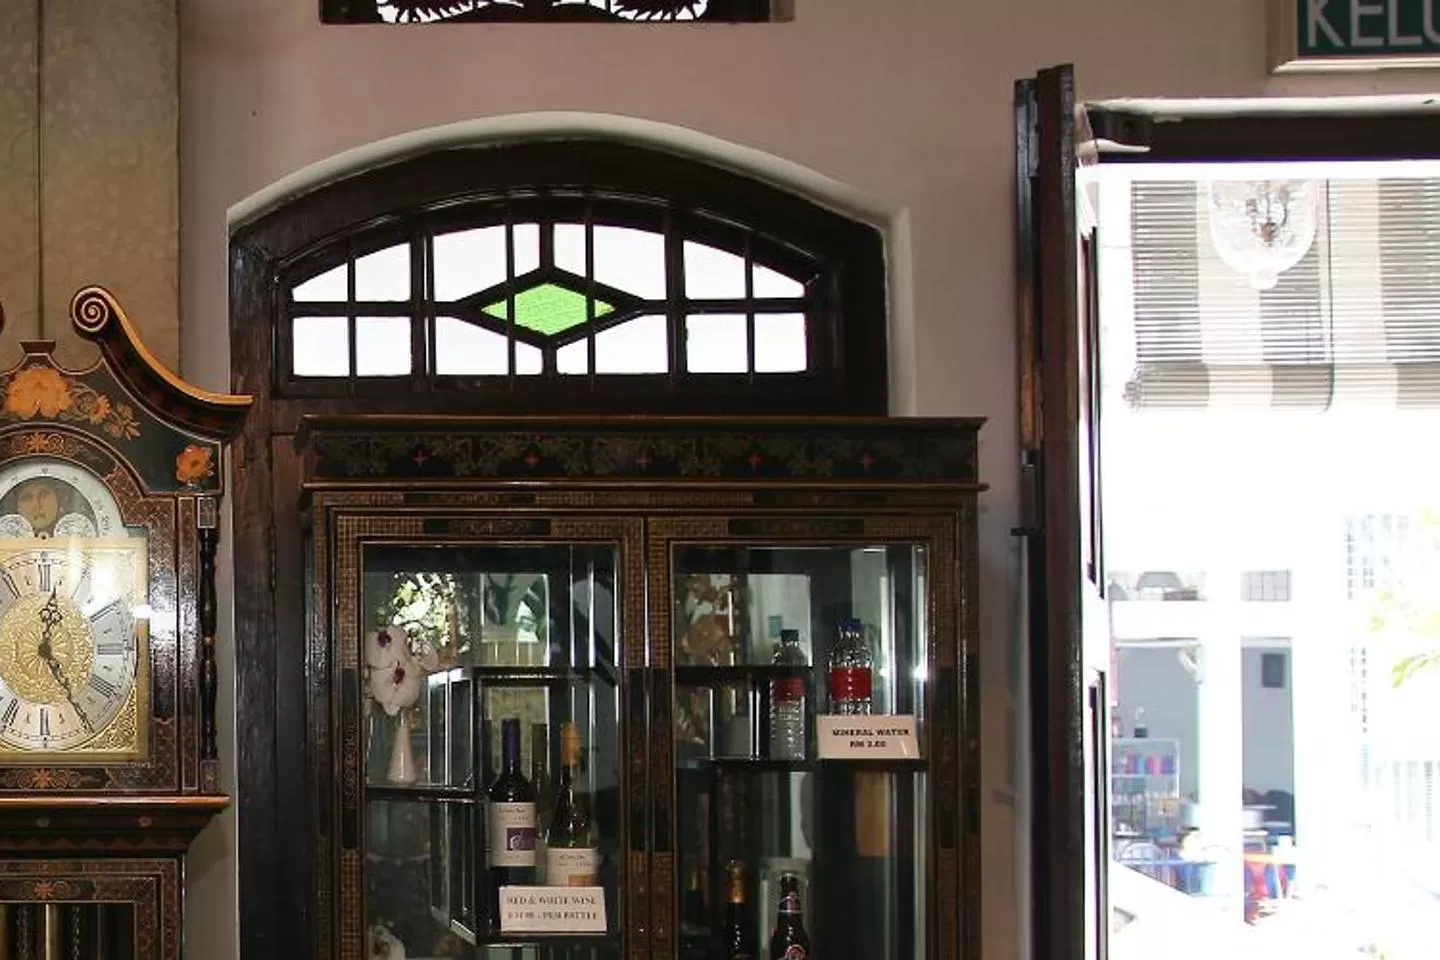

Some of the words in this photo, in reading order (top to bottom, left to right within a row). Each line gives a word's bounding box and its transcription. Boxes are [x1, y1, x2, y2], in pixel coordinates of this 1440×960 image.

[1307, 0, 1440, 47] KEL
[832, 728, 874, 737] MINERAL
[876, 728, 909, 736] WATER
